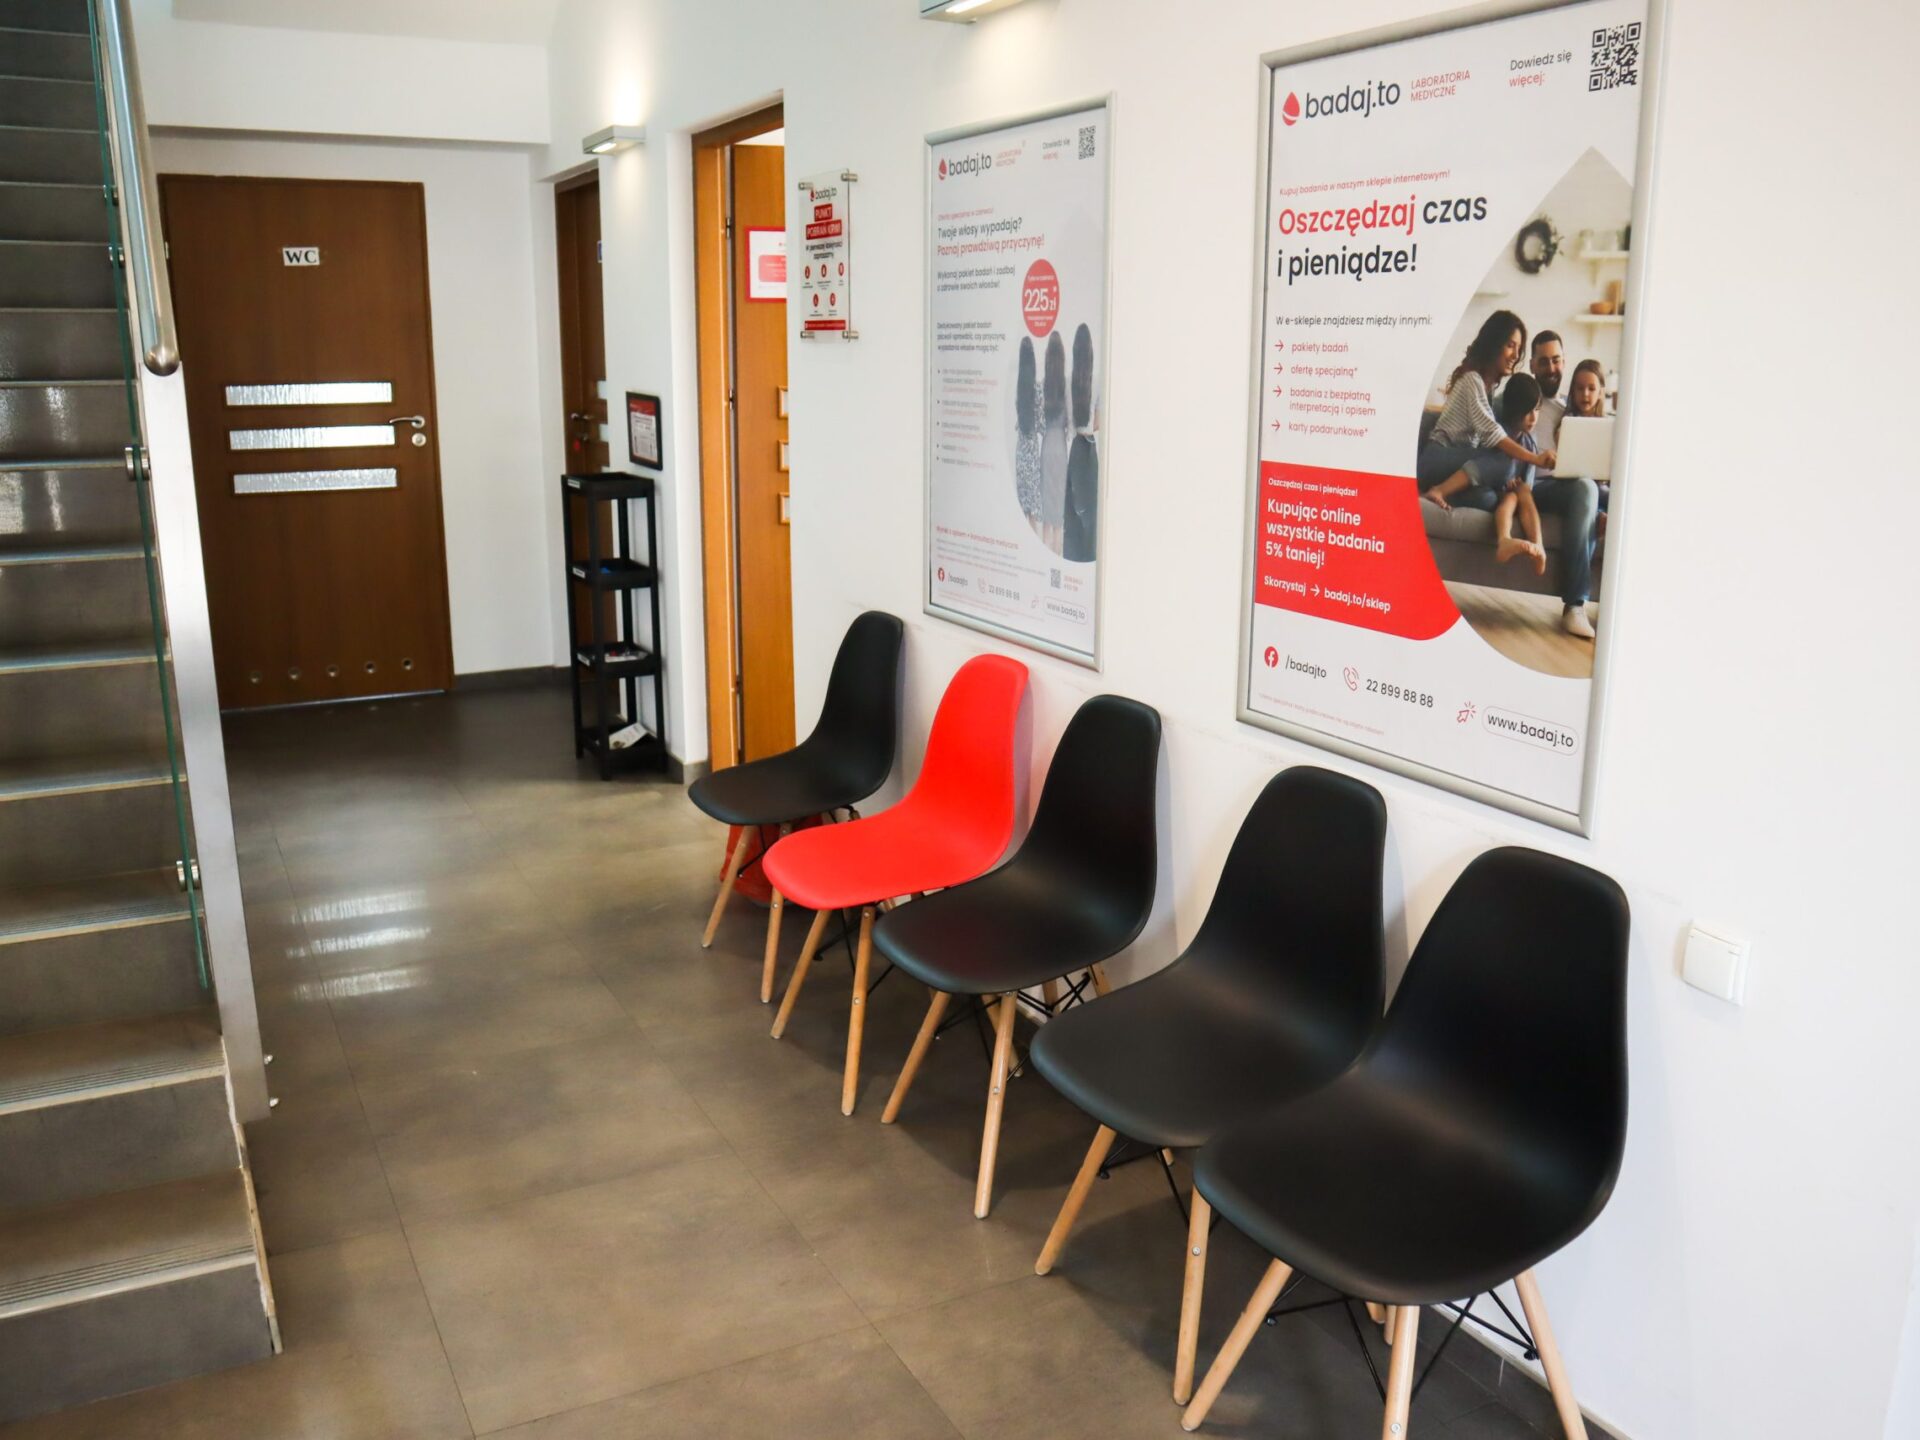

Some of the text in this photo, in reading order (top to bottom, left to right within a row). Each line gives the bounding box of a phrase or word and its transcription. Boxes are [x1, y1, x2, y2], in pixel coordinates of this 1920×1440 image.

[1510, 49, 1572, 71] Dowiedz się
[1411, 70, 1471, 90] LABORATORIA
[1509, 71, 1545, 88] więcej:
[1305, 80, 1401, 119] badaj.to
[1410, 85, 1456, 102] MEDYCZNE
[948, 152, 992, 176] badaj.to
[1279, 186, 1299, 198] Kupuj
[1300, 184, 1328, 194] badania
[1336, 181, 1365, 191] naszym
[1366, 177, 1392, 188] sklepie
[1393, 170, 1450, 184] internetowym!
[1278, 194, 1488, 237] Oszczędzaj czas
[938, 226, 957, 240] Twoje
[980, 216, 1023, 236] wypadają?
[285, 250, 317, 264] WC
[1277, 243, 1418, 285] i pieniądze!
[1024, 288, 1049, 311] 225
[1275, 314, 1433, 329] W e-sklepie znajdziesz między innymi:
[1291, 341, 1349, 355] pakiety badań
[1291, 365, 1313, 376] ofertę
[1290, 388, 1323, 399] badania
[1330, 388, 1371, 403] bezpłatną
[1289, 402, 1339, 415] interpretacją
[1345, 405, 1376, 418] opisem
[1288, 421, 1308, 434] karty
[1268, 477, 1303, 491] Oszczędzaj
[1303, 483, 1319, 492] czas
[1322, 485, 1358, 497] pieniądze!
[1267, 498, 1361, 526] Kupując online
[1266, 521, 1385, 554] wszystkie badania
[1265, 541, 1325, 569] 5% taniej!
[1264, 575, 1391, 615] Skorzystaj badaj.to/sklep
[1285, 655, 1327, 679] /badajto
[1365, 678, 1434, 708] 22 899 88 88
[1487, 713, 1574, 748] www.badaj.to
